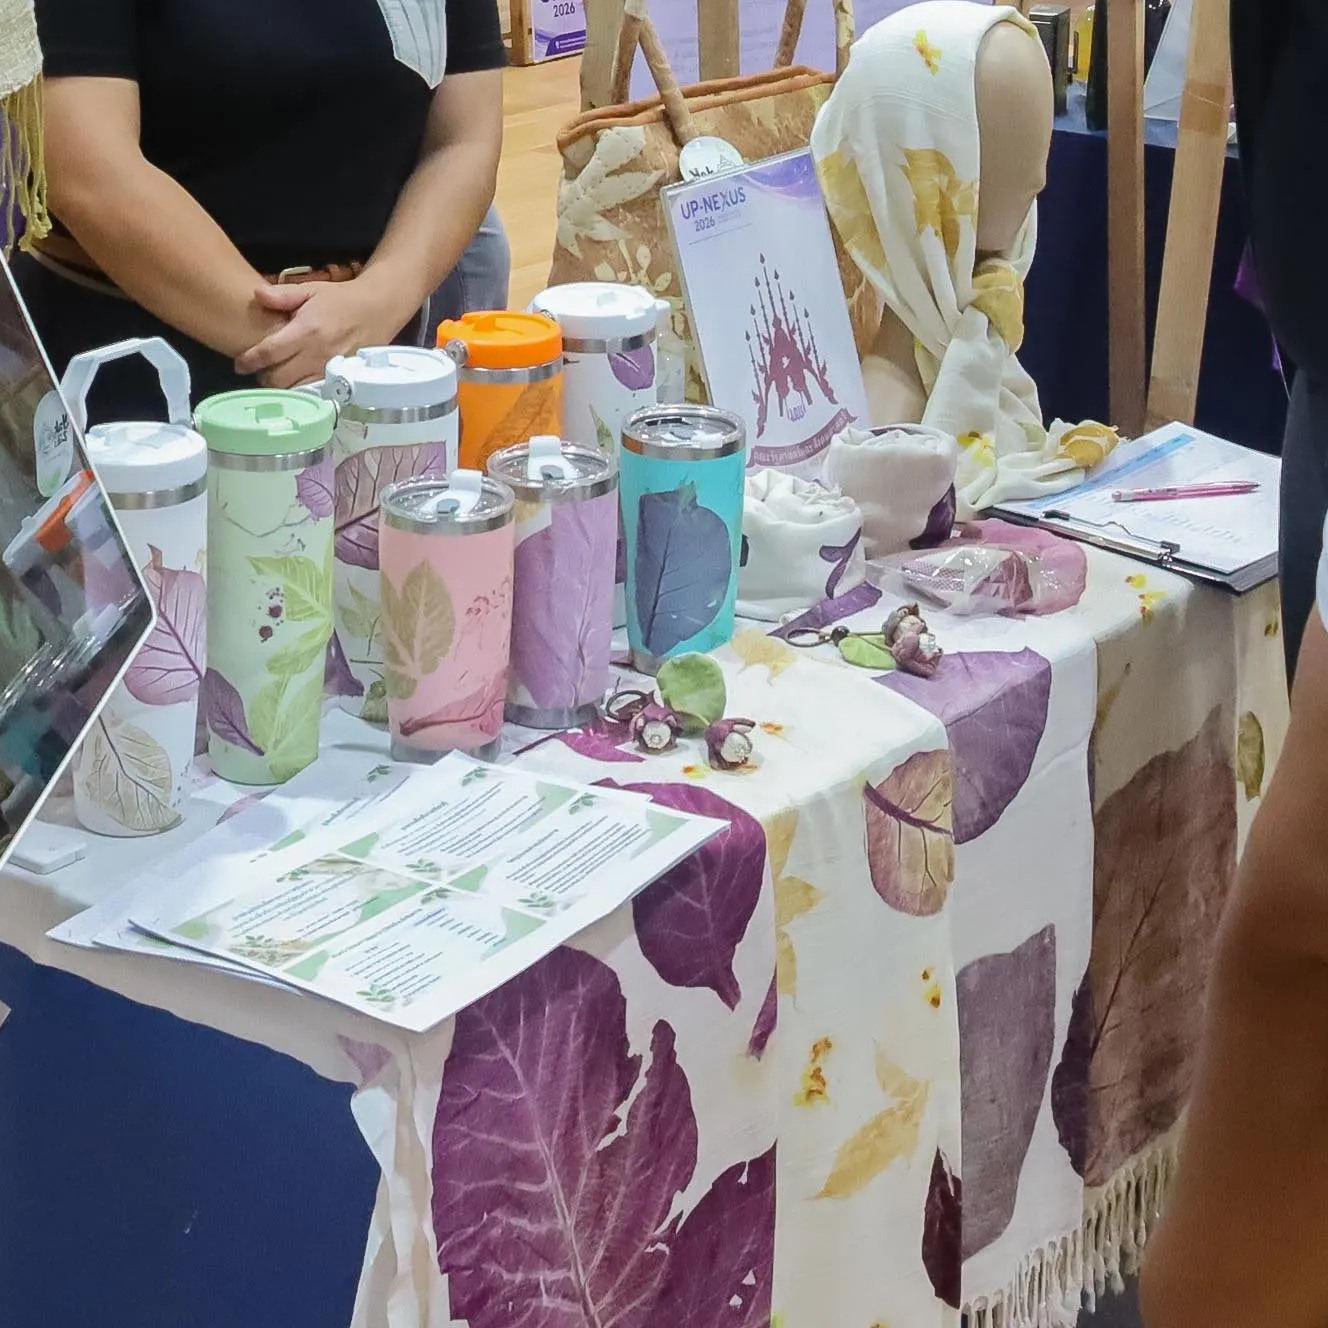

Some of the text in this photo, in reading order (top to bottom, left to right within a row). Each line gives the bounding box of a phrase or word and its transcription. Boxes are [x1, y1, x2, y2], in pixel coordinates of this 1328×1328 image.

[553, 2, 576, 18] 2026
[680, 186, 746, 220] UP-NEXUS
[694, 216, 716, 232] 2026
